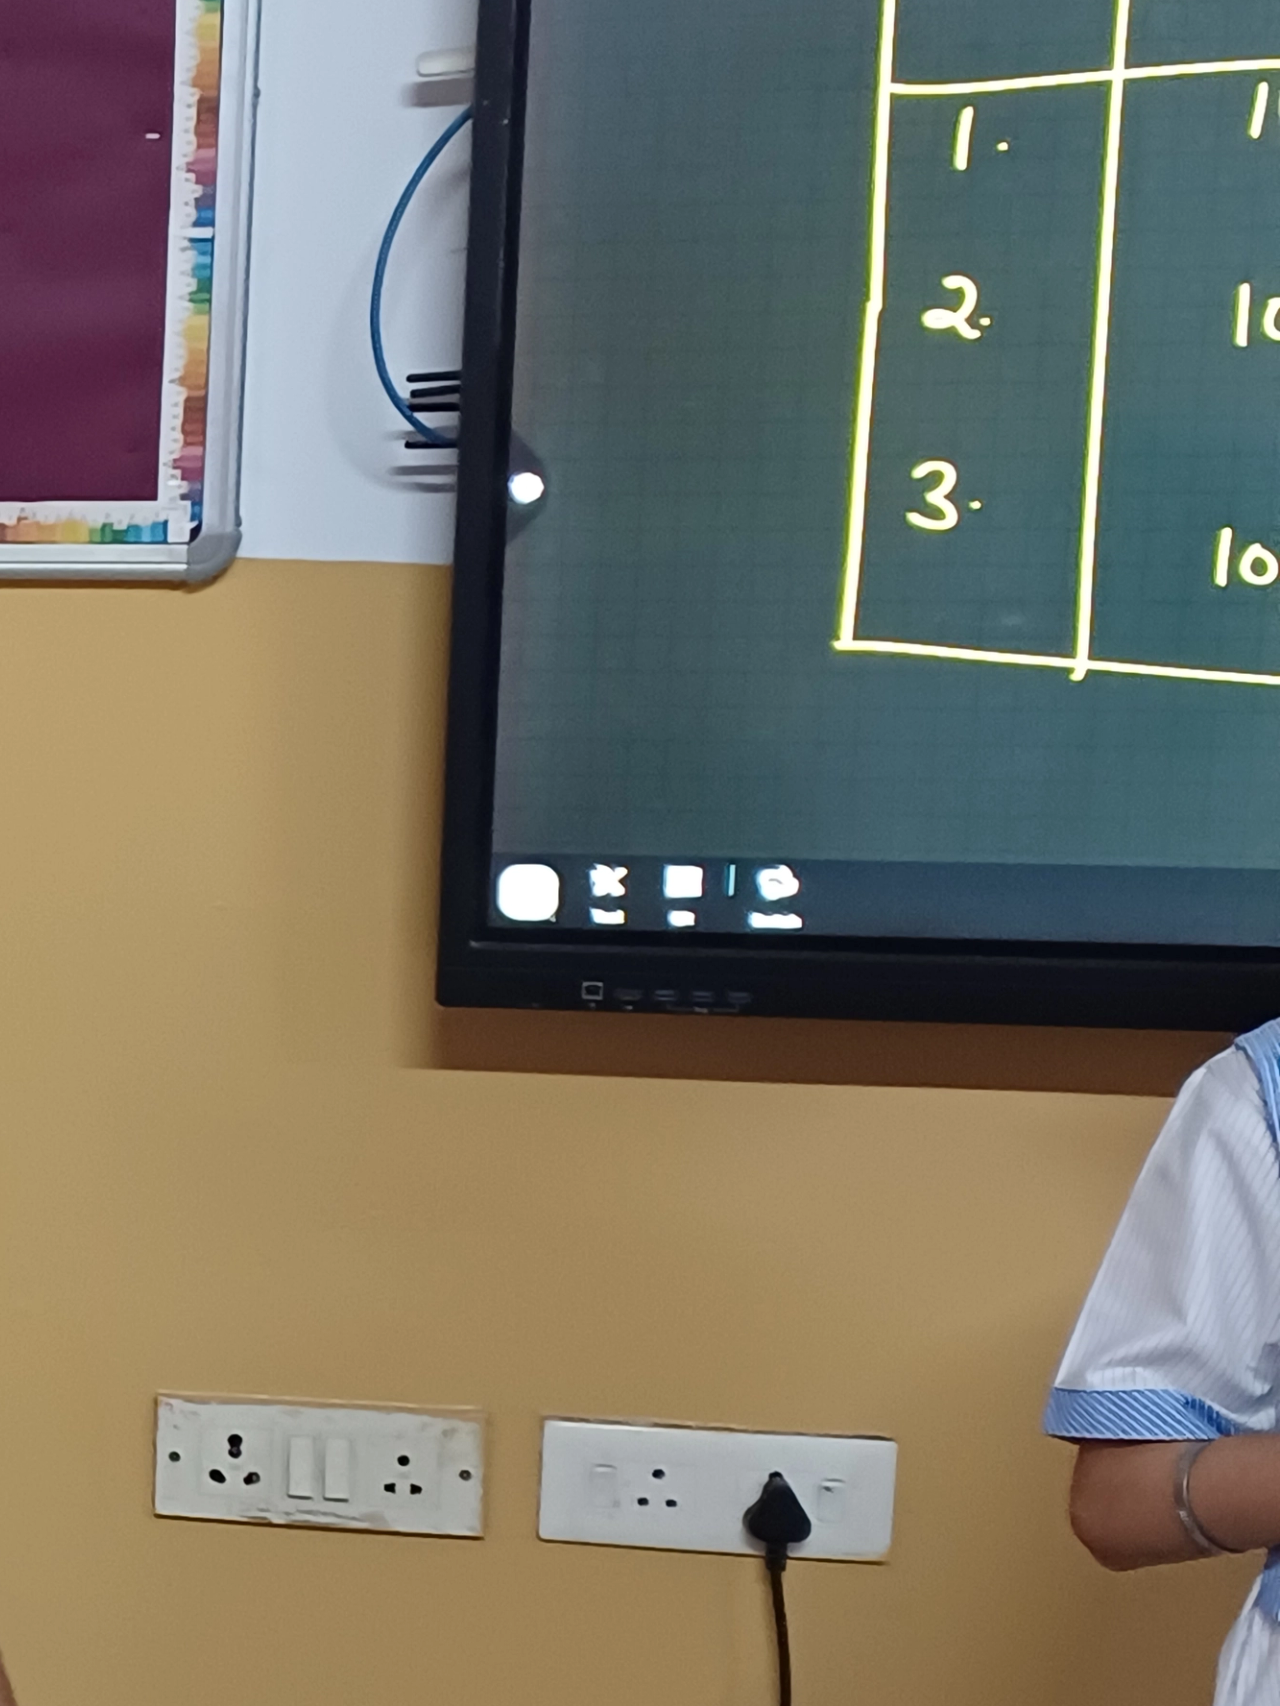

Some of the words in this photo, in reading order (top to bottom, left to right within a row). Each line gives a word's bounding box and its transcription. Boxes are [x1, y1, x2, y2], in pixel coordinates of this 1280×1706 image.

[921, 274, 992, 341] 2.
[905, 460, 983, 531] 3.
[1212, 526, 1280, 588] 10
